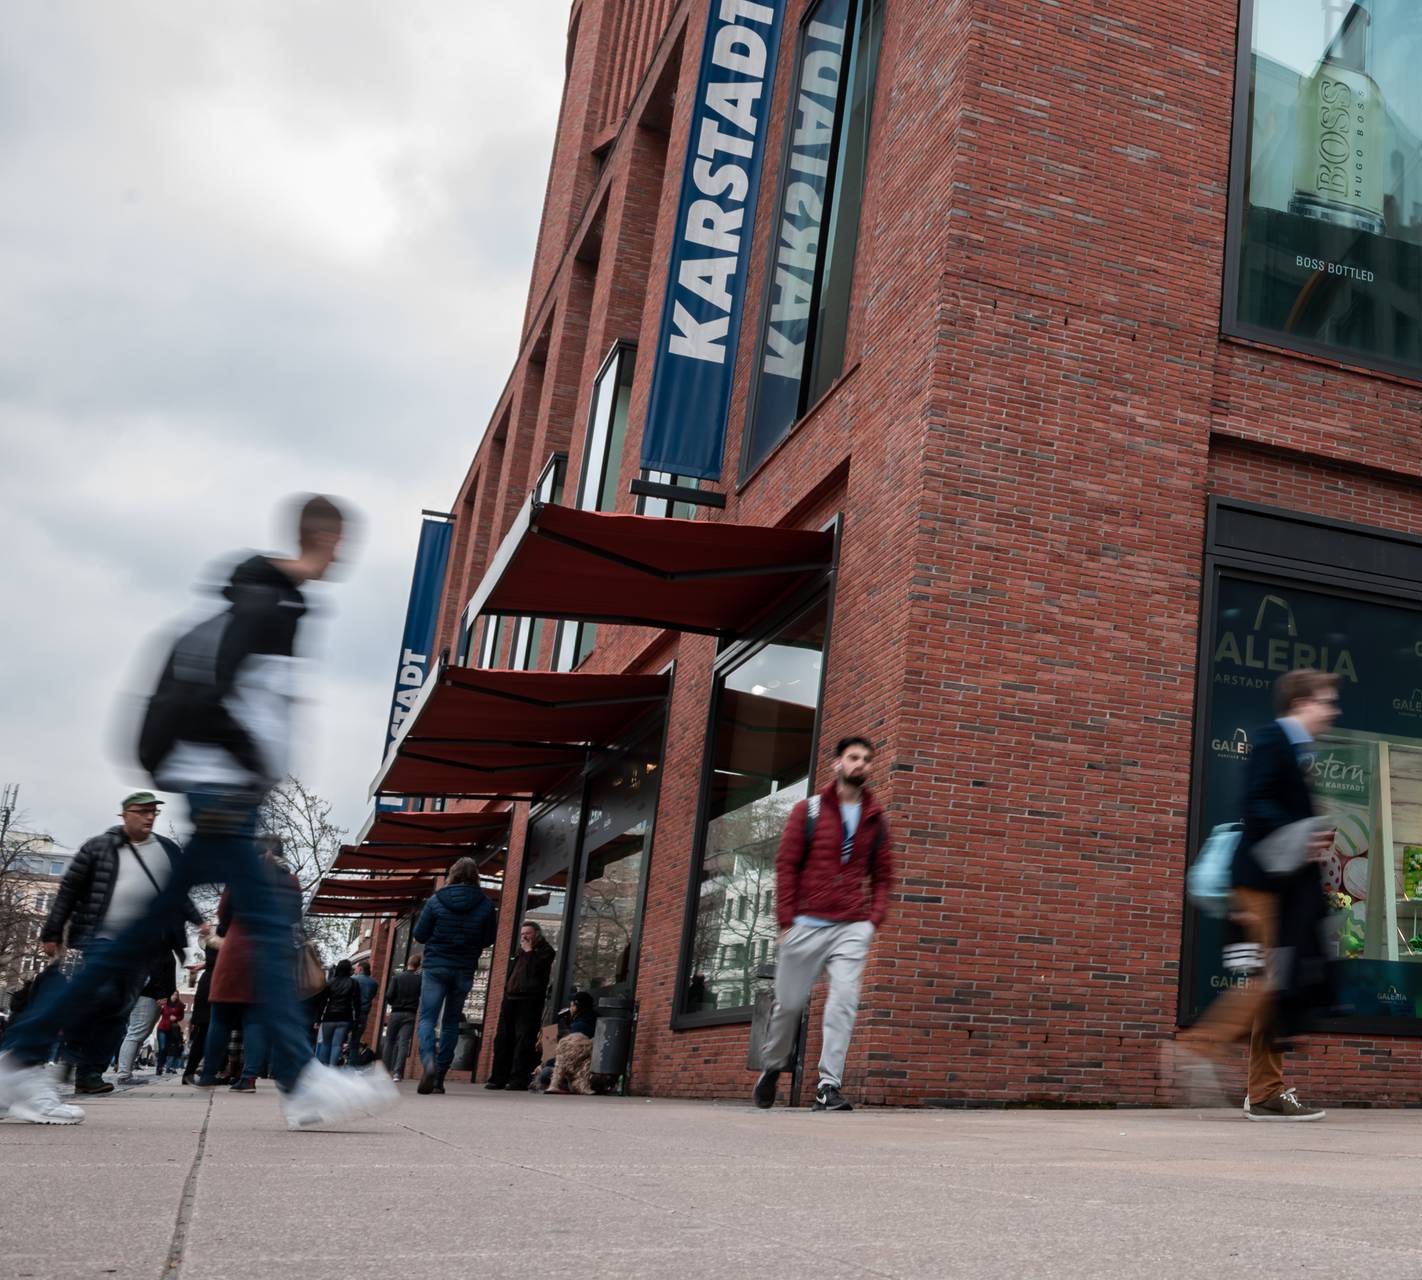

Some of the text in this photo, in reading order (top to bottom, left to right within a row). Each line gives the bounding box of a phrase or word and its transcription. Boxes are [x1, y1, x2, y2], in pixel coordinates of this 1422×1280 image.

[1317, 81, 1351, 197] BOSS
[668, 0, 774, 364] KARSTADT
[1355, 149, 1364, 197] HUGO
[1296, 255, 1374, 282] BOSS BOTTLED
[1214, 631, 1360, 683] ALERIA
[1214, 672, 1271, 689] ARSTADT
[1211, 738, 1254, 754] GALER
[1325, 781, 1365, 792] KARSTADT
